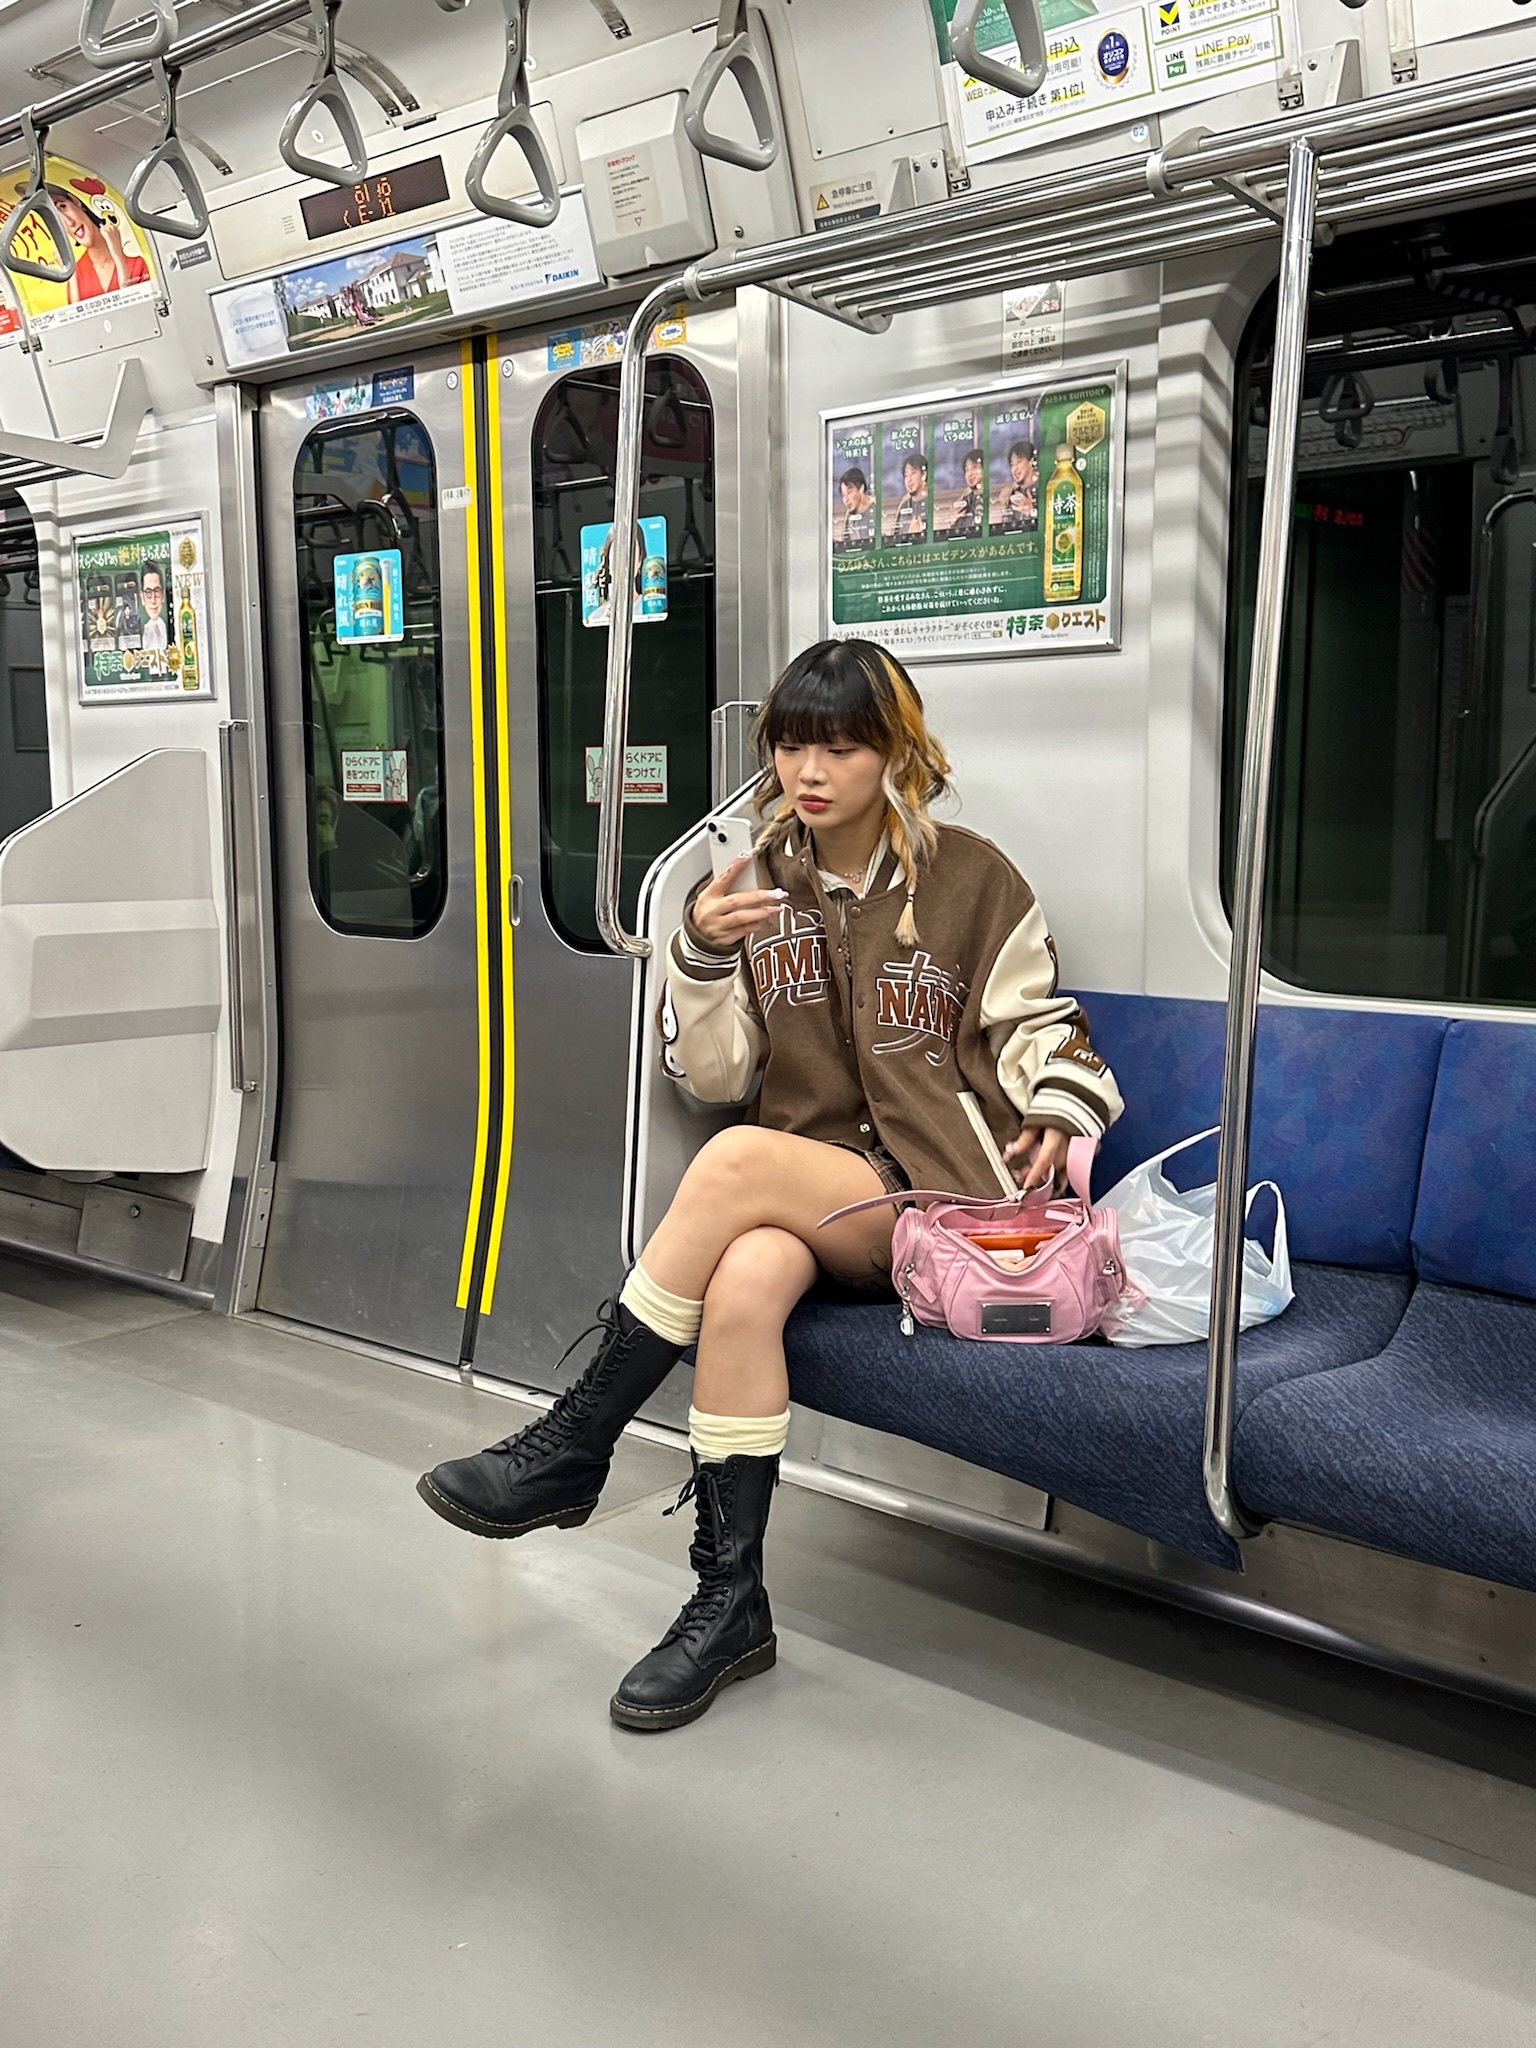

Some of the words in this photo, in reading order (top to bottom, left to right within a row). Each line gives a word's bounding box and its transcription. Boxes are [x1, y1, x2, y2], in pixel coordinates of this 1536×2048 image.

[1161, 25, 1181, 36] POINT
[1049, 36, 1080, 58] 申込
[1195, 37, 1224, 57] LINE
[1228, 33, 1252, 49] Pay
[1103, 48, 1125, 60] オリコン
[1165, 51, 1185, 62] LINE
[1168, 62, 1185, 75] Pay
[985, 94, 1048, 122] 申込み手続き
[1050, 81, 1086, 103] 第1位!
[1133, 126, 1145, 137] 62
[831, 180, 873, 199] 急停車に注意
[552, 269, 579, 282] DAIKIN
[1012, 326, 1052, 339] マナーモードに
[1069, 388, 1106, 401] SUNTORY
[995, 409, 1034, 425] 減りません
[943, 418, 974, 433] 脂肪って
[890, 428, 919, 442] 飲んだと
[943, 430, 974, 443] いうのは
[836, 434, 873, 450] トクホのお茶
[1051, 493, 1080, 515] 特茶
[838, 541, 1039, 572] ひろゆきさん、こちらにはエビデンスがあるんです。
[175, 572, 204, 589] NEW
[1006, 614, 1044, 640] 特茶
[1061, 609, 1106, 633] クエスト
[94, 650, 123, 681] 特茶
[133, 648, 168, 677] クエスト
[345, 756, 381, 767] ひらくドアに
[625, 752, 663, 763] らくドアに
[346, 770, 380, 780] きをつけて!
[625, 767, 661, 778] をつけて!
